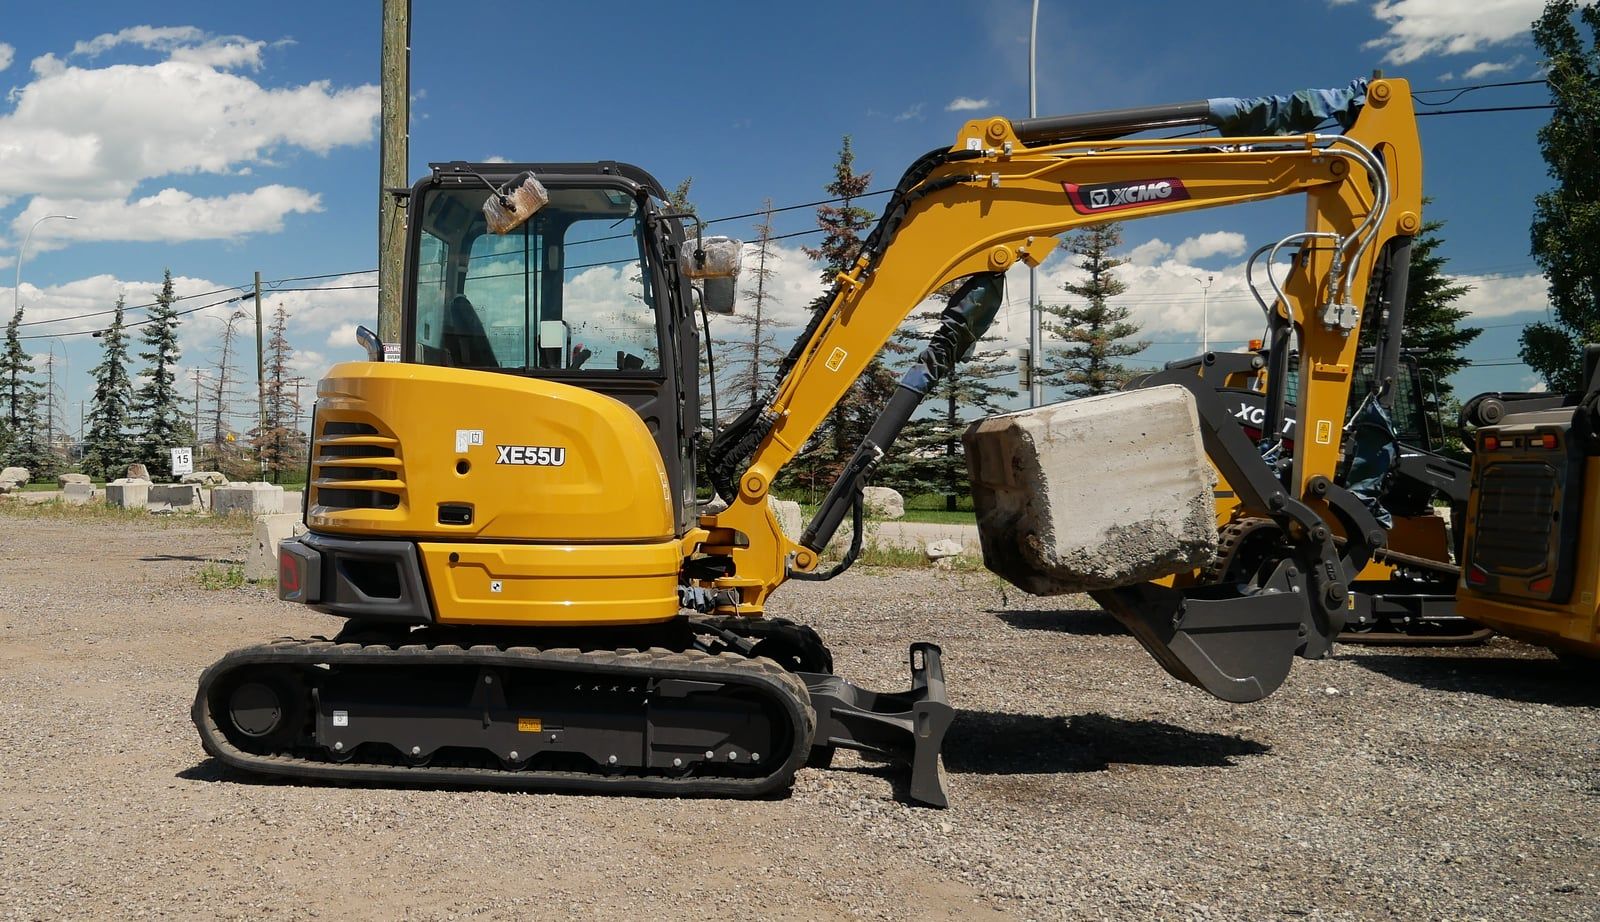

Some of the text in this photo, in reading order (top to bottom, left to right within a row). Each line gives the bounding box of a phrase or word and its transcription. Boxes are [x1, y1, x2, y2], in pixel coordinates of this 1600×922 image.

[1111, 182, 1172, 205] XCMG
[177, 454, 189, 464] 15
[496, 445, 565, 467] XE55U
